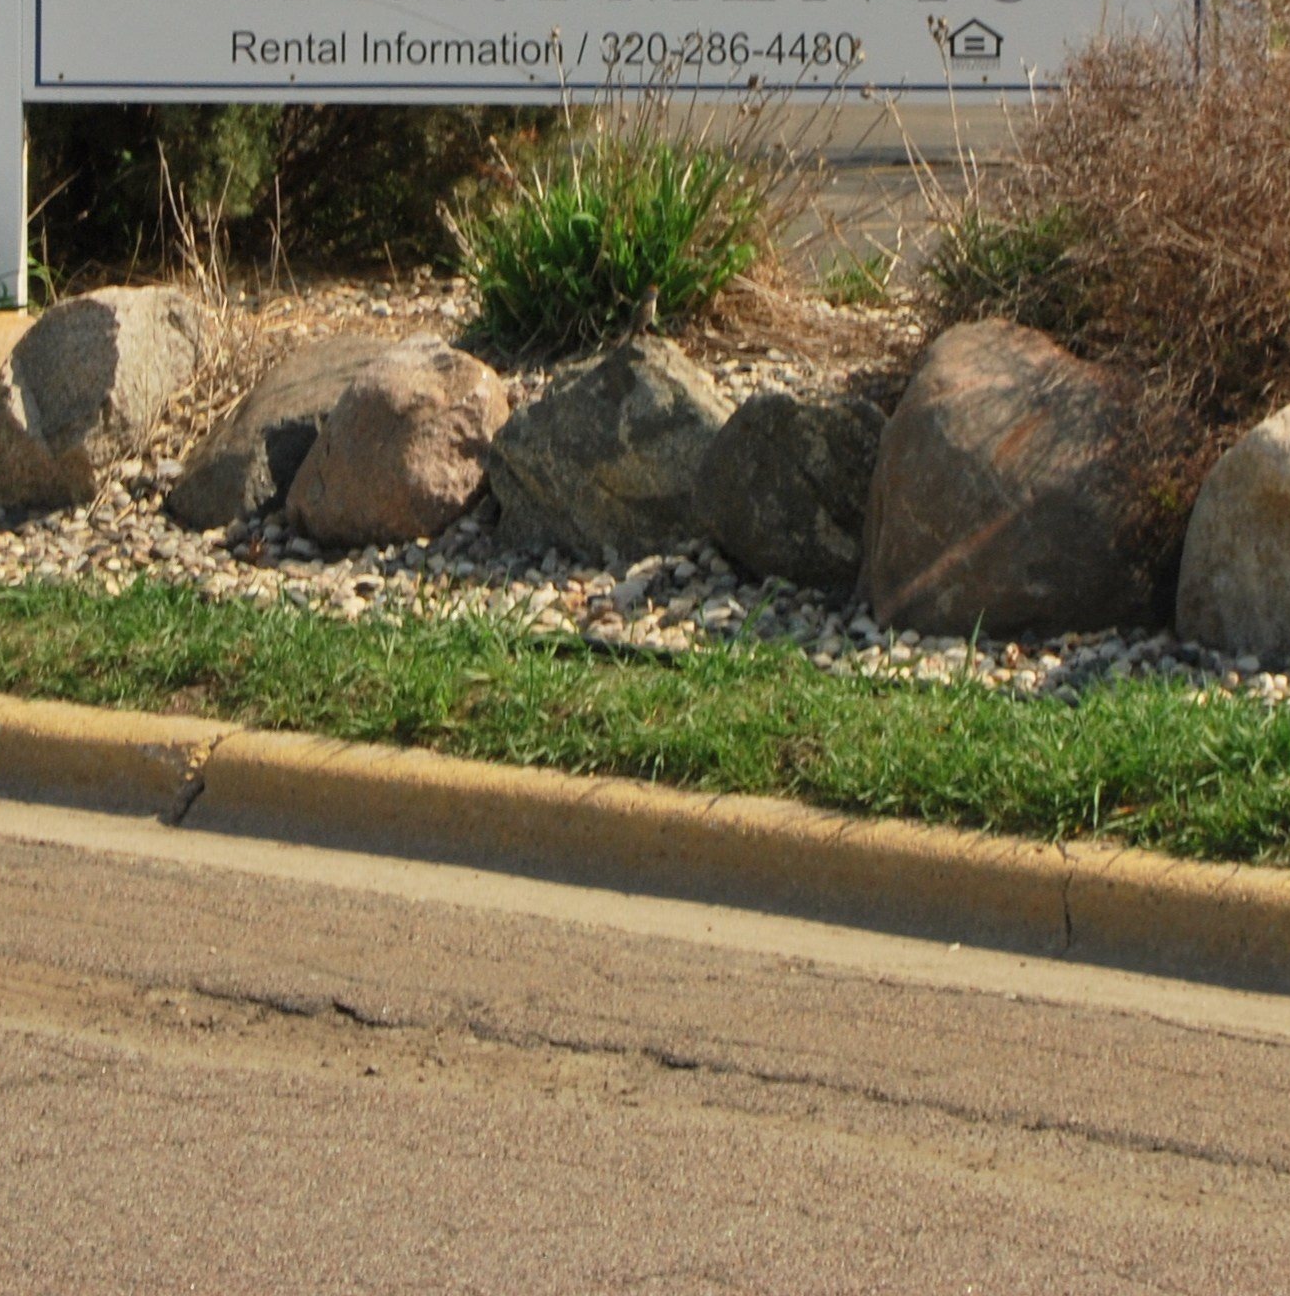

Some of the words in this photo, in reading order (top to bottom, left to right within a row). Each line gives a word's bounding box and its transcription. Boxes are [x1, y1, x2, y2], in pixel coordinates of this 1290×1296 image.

[231, 31, 346, 65] Rental
[362, 31, 563, 65] Information
[576, 32, 589, 65] /
[601, 32, 855, 66] 320-286-4480
